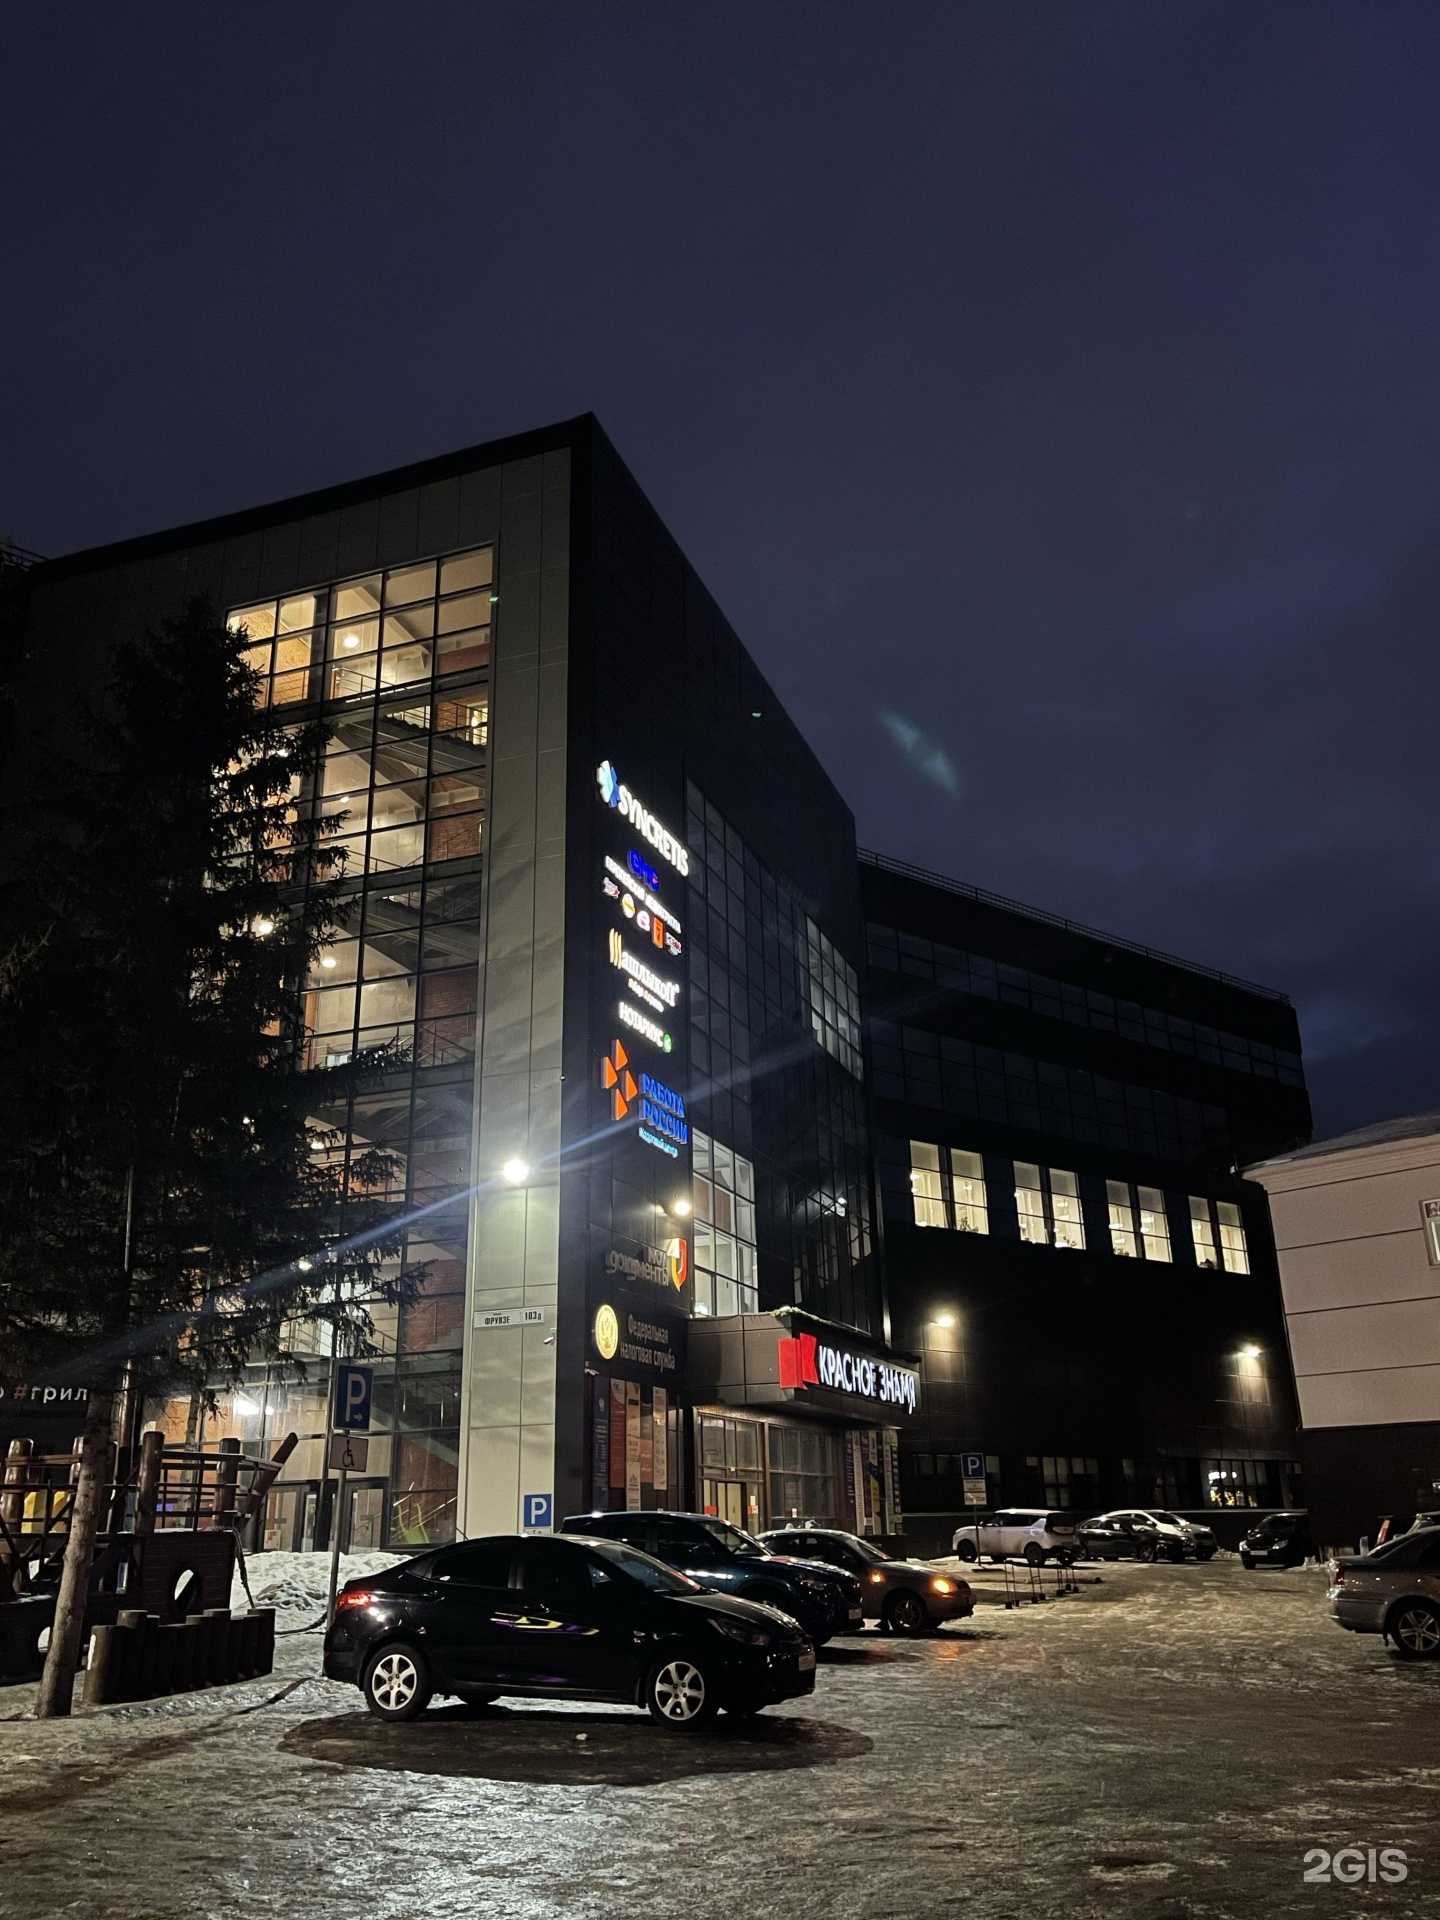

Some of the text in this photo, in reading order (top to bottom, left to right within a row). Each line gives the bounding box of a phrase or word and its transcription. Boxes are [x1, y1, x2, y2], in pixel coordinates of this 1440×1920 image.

[619, 785, 688, 876] SYNCRETIS
[640, 1073, 685, 1118] РАБОТА
[640, 1100, 688, 1144] РОССИИ
[628, 1314, 669, 1344] Федеральная
[620, 1343, 653, 1365] налоговая
[14, 1383, 88, 1403] #грил
[818, 1345, 916, 1415] КРАСНОЕ ЗНАМЯ
